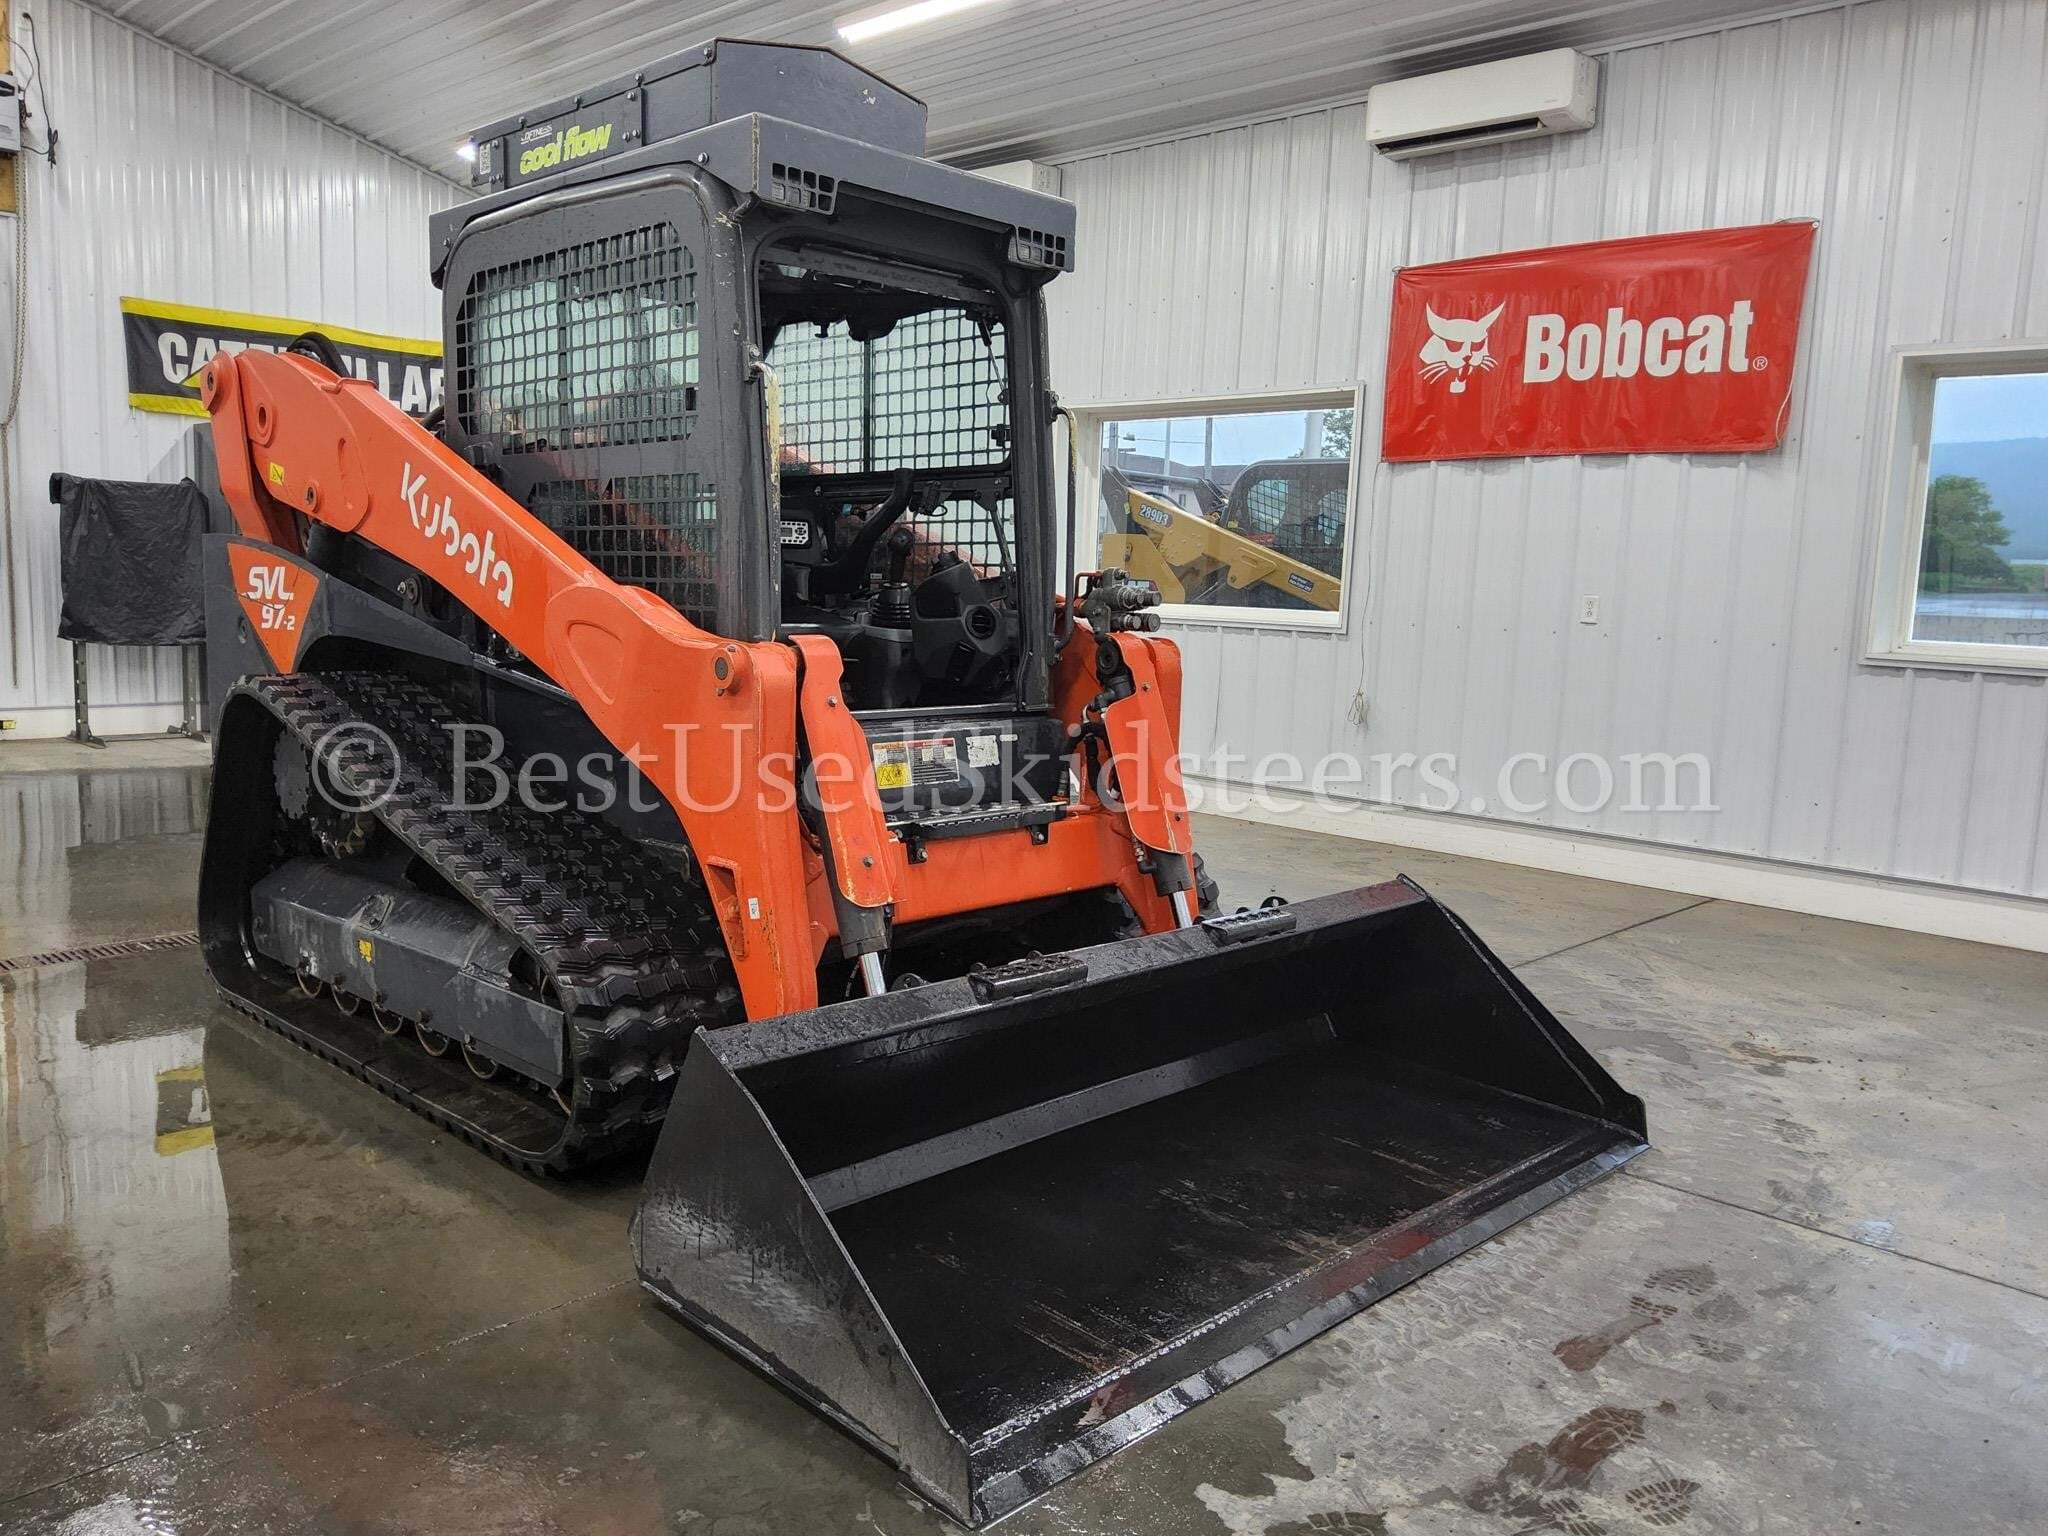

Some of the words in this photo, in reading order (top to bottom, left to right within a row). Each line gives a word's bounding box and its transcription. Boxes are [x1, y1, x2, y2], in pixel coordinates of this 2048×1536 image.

[519, 131, 563, 175] cool
[563, 123, 613, 161] flow
[1139, 504, 1169, 526] 289D3
[400, 461, 514, 609] Kubota
[242, 566, 294, 600] SVL
[261, 603, 296, 631] 97-2
